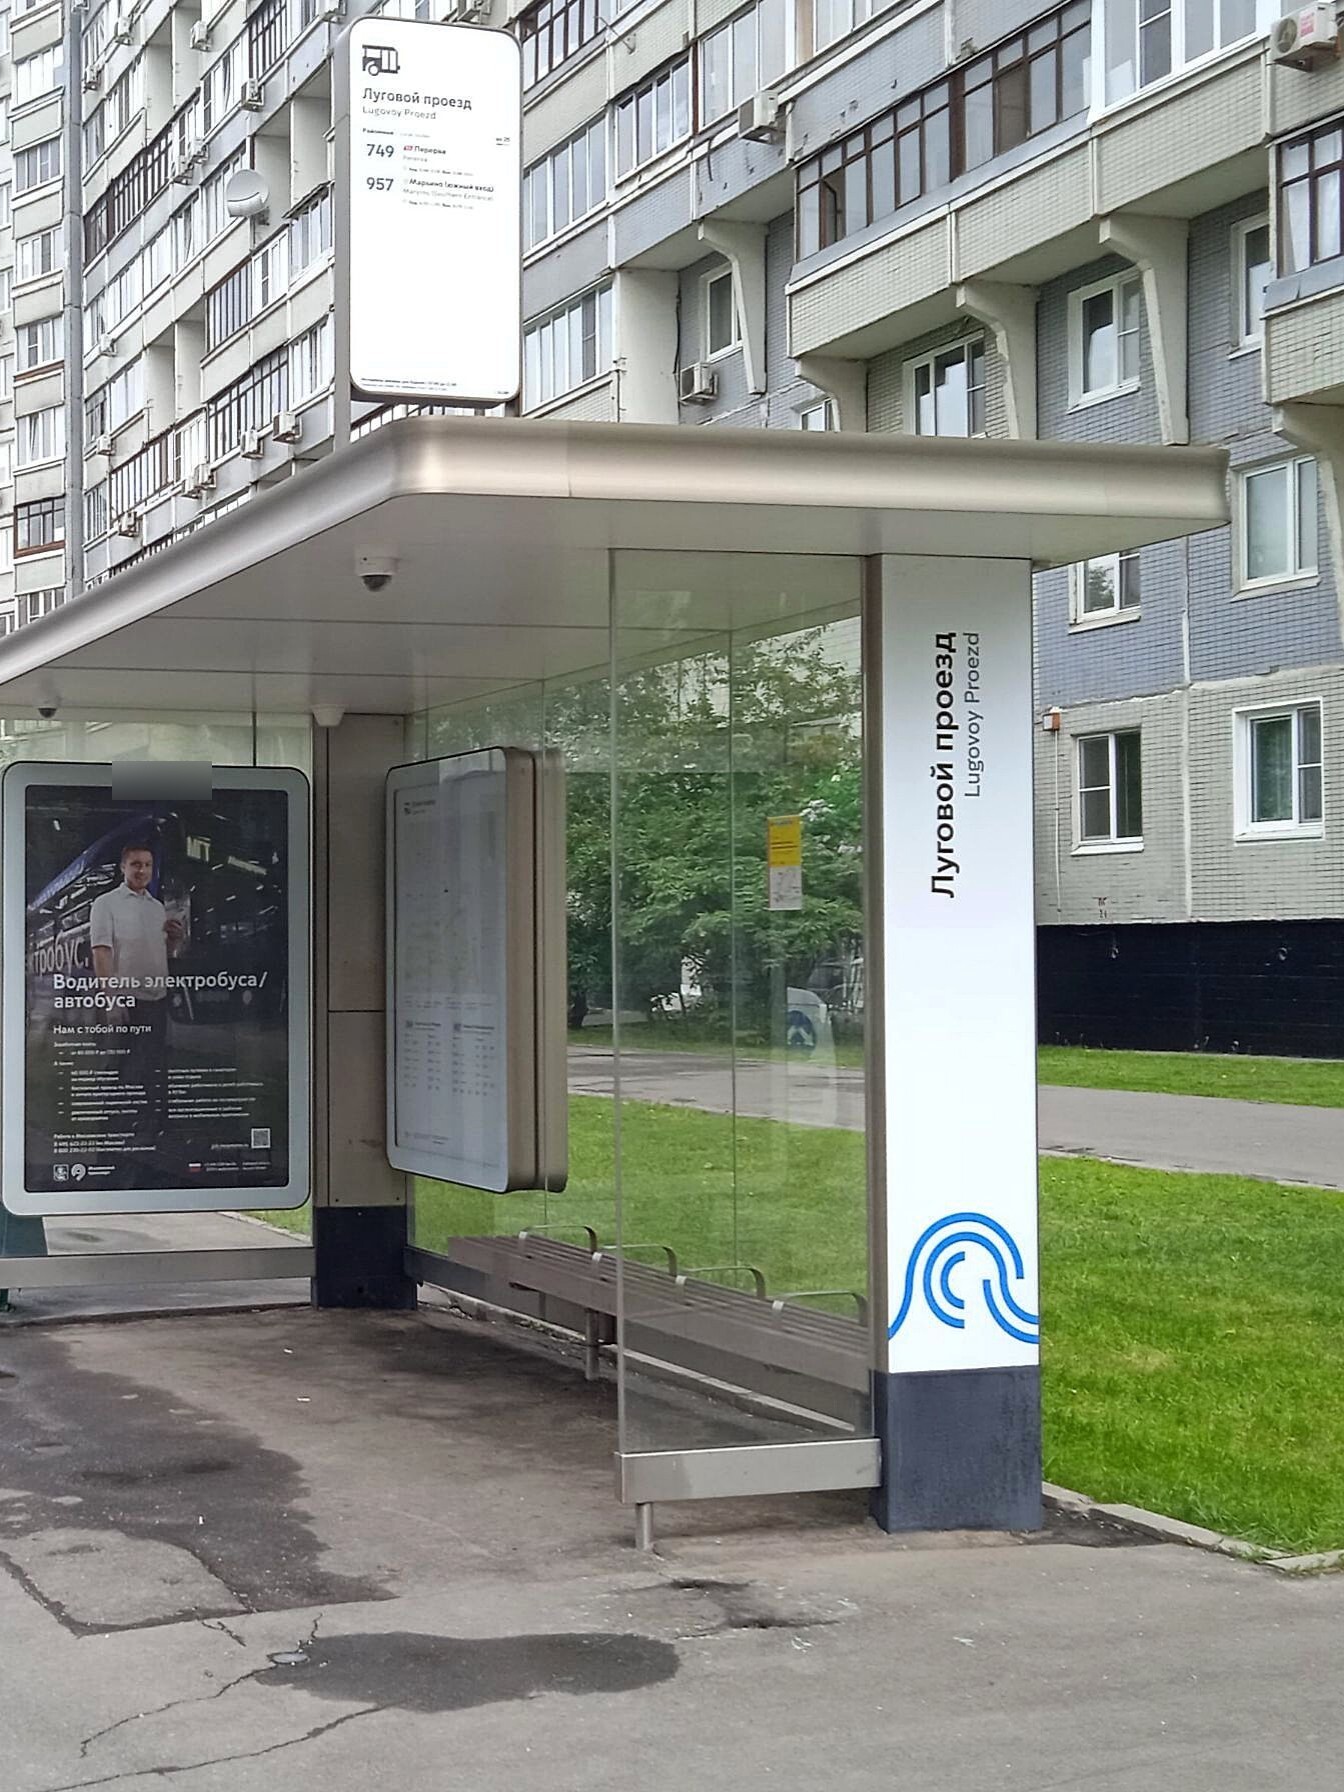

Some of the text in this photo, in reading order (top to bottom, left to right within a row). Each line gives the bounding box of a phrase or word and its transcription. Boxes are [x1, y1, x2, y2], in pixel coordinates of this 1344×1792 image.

[362, 87, 472, 111] Луговой проезд
[362, 106, 436, 120] Lugovoy Proezd
[366, 143, 395, 158] 749
[366, 176, 394, 191] 957
[963, 632, 984, 797] Lugovoy Proezd
[930, 632, 960, 899] Луговой проезд
[53, 973, 141, 989] Водитель
[54, 992, 136, 1011] автобуса
[53, 1025, 75, 1034] Нам
[84, 1023, 113, 1034] тобой
[115, 1025, 128, 1033] по
[129, 1024, 152, 1034] пути
